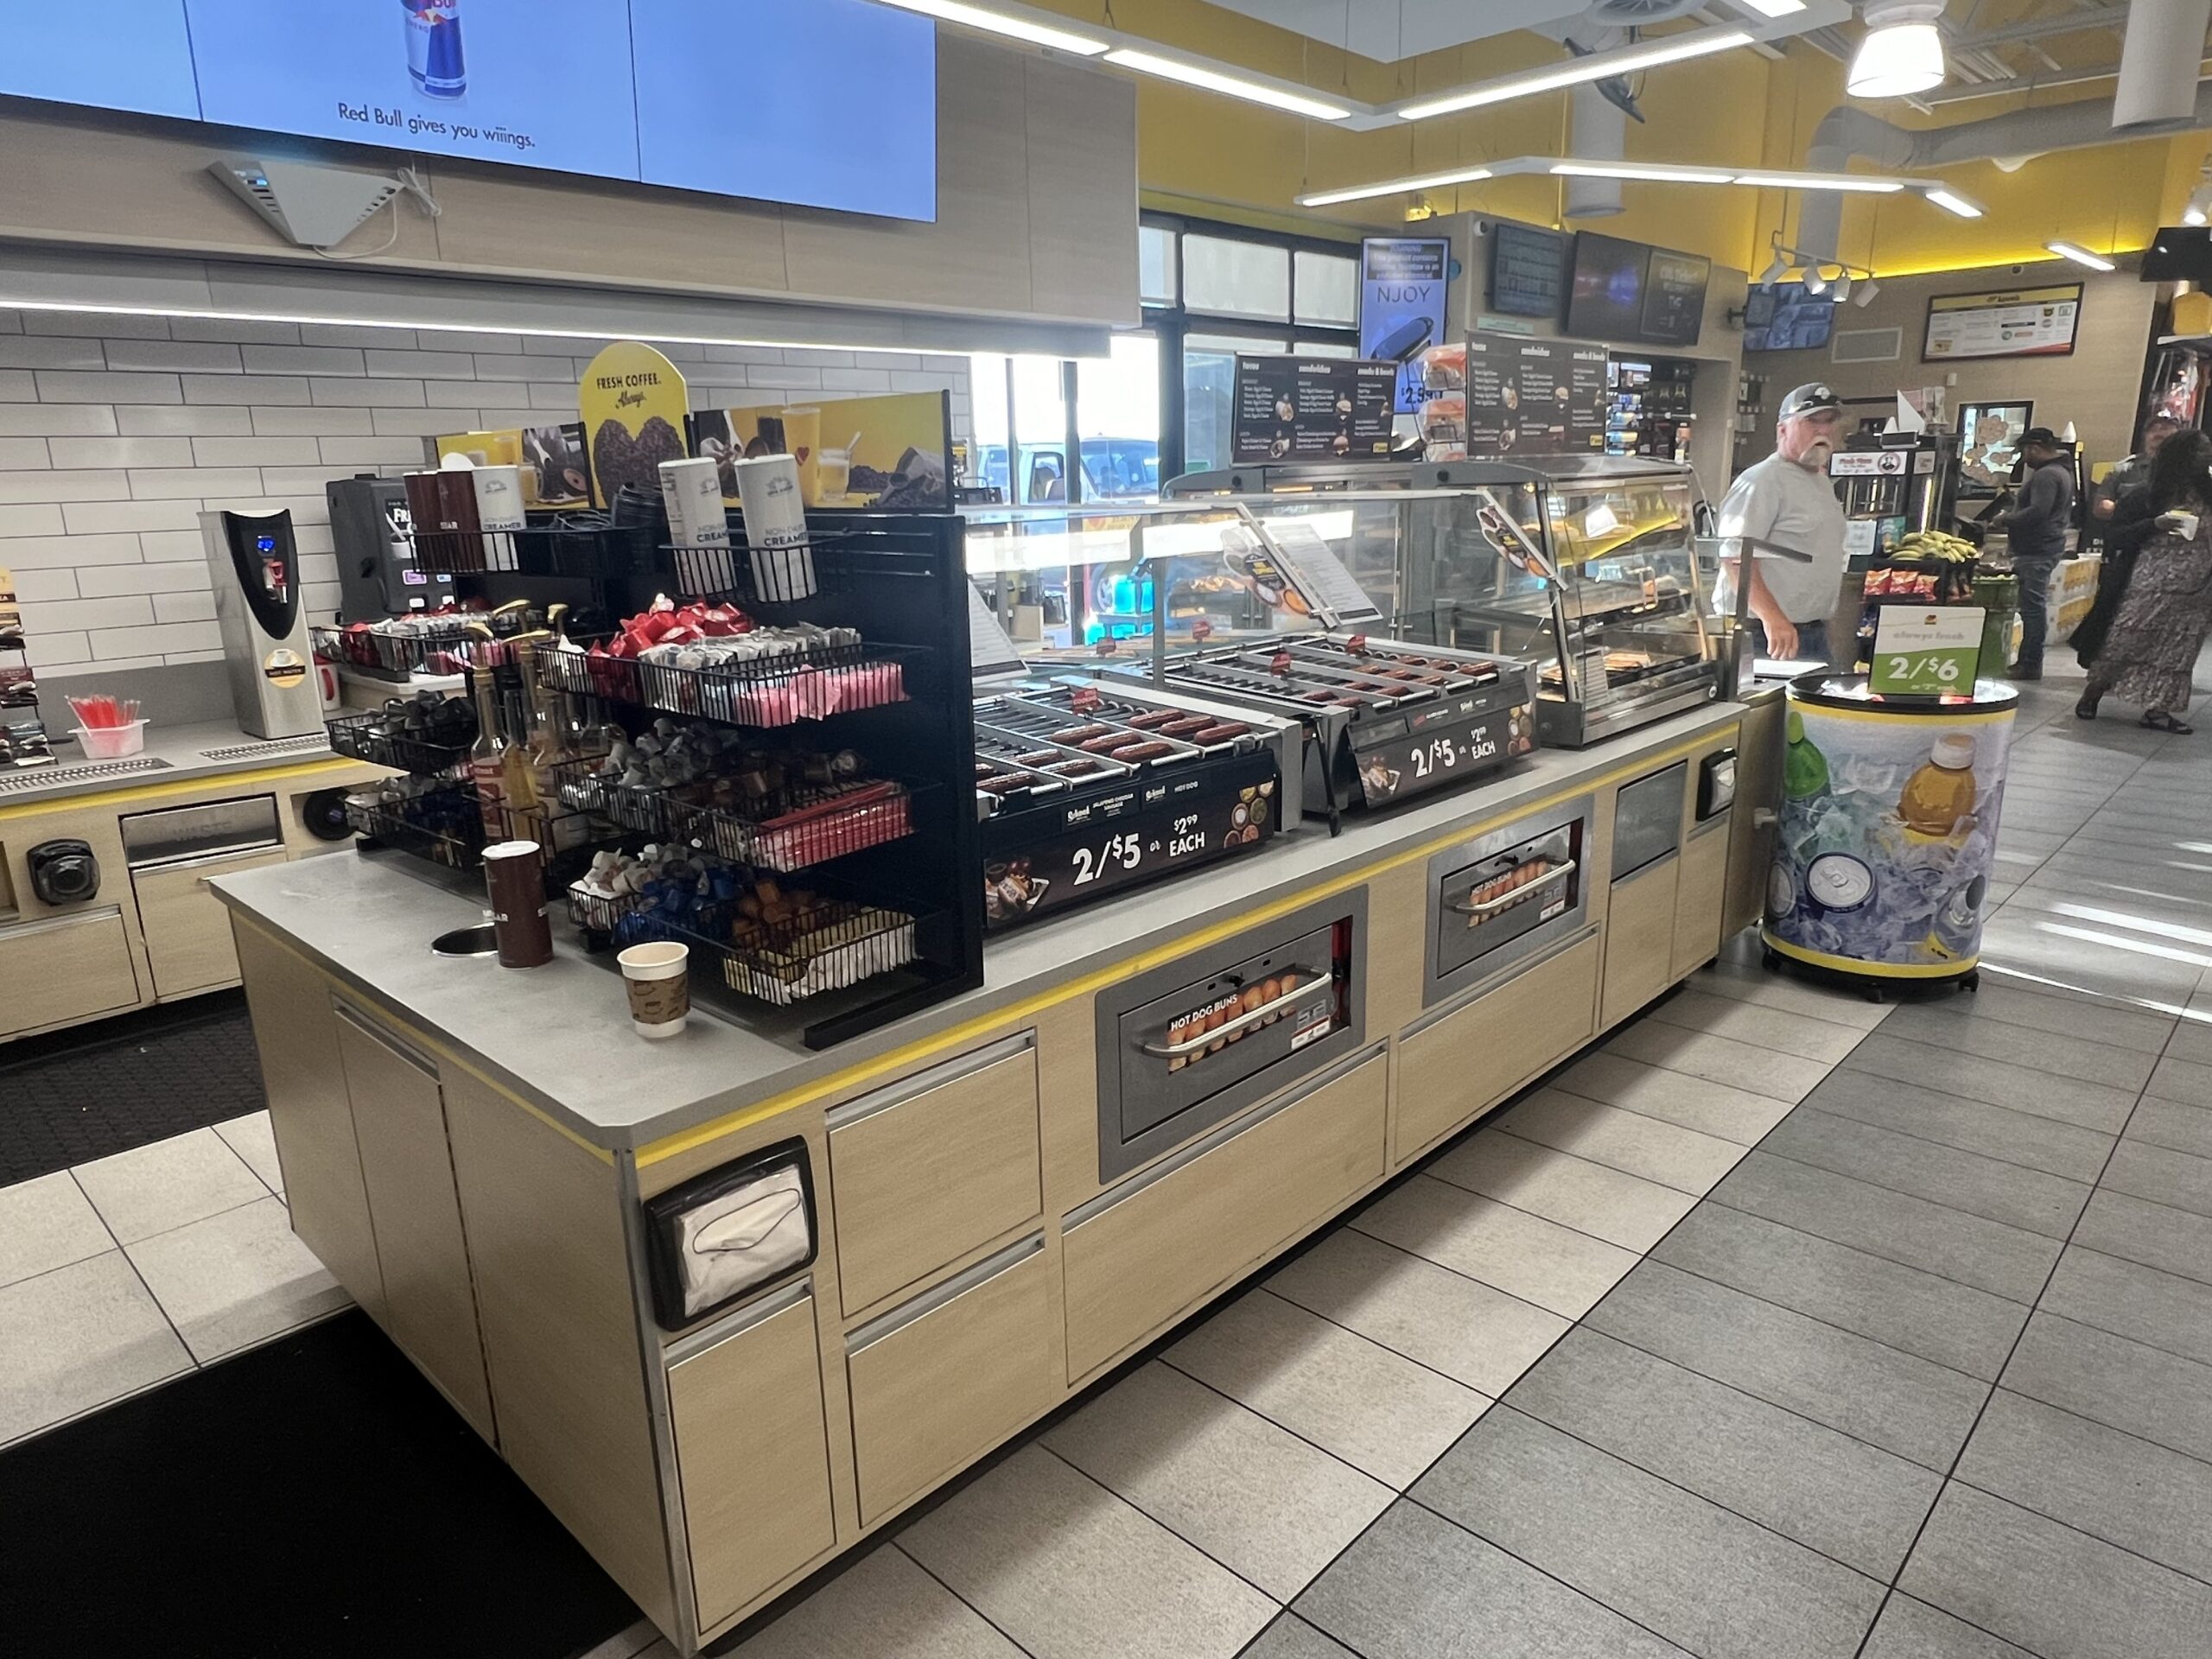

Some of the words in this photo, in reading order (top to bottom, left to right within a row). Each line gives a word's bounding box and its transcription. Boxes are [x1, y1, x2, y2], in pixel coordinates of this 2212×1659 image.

[338, 102, 370, 123] Red
[374, 107, 403, 128] Bull
[408, 114, 447, 134] gives
[450, 124, 479, 141] you
[1377, 286, 1430, 303] NJOY
[596, 375, 624, 390] FRESH
[625, 372, 663, 388] COFFEE.
[1888, 657, 1959, 681] 2/$6
[1411, 739, 1455, 778] 2/$5
[1471, 741, 1496, 760] EACH
[1186, 781, 1198, 790] DOG
[1169, 831, 1205, 857] EACH
[1072, 832, 1141, 886] 2/$5
[1149, 840, 1162, 852] or
[1171, 1014, 1192, 1032] HOT
[1192, 1005, 1213, 1023] DOG
[1214, 994, 1239, 1011] BUNS
